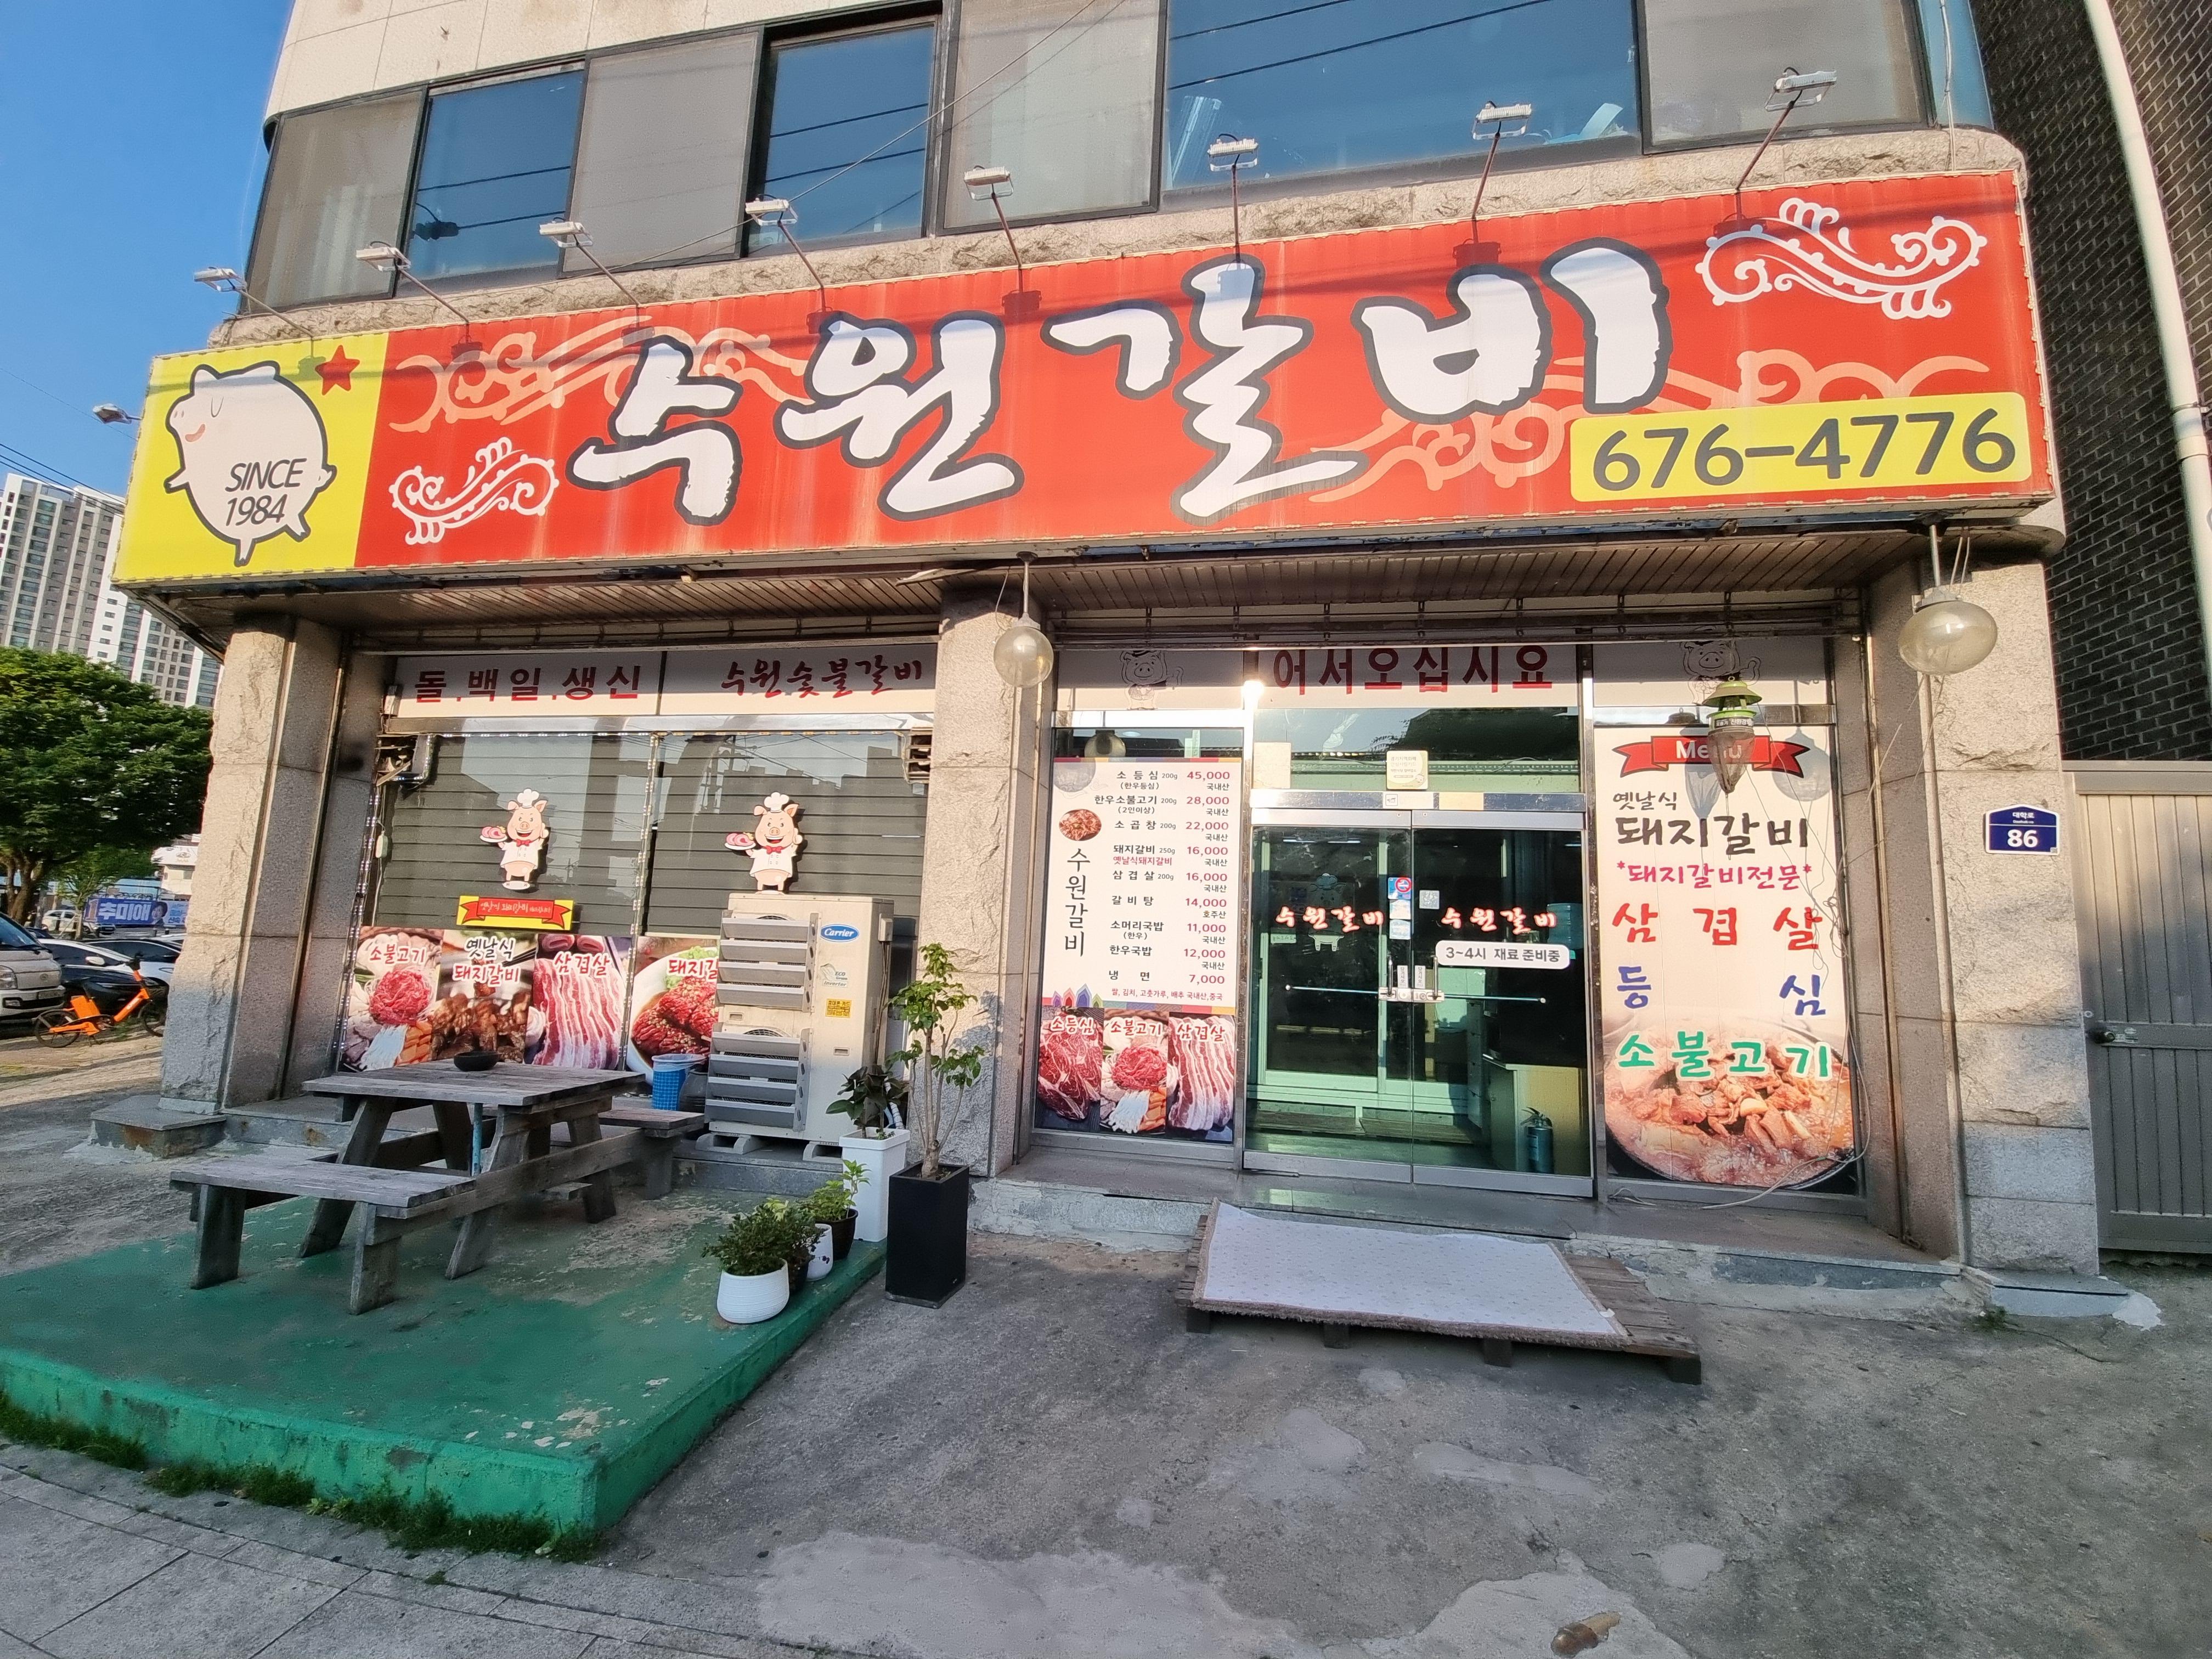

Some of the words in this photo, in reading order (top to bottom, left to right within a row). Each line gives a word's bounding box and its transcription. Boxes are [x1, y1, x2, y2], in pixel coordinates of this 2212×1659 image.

[566, 237, 1673, 526] 수원갈비
[1593, 408, 2016, 491] 676-4776
[225, 457, 308, 493] SINCE
[226, 494, 289, 526] 1984
[721, 654, 923, 699] 수원숯불갈비
[1273, 645, 1552, 695] 어서오십시요
[1187, 771, 1230, 781] 45,000
[1120, 782, 1159, 791] (한우등심)
[1207, 783, 1229, 791] 국내산
[1094, 795, 1157, 805] 한우소불고기
[1186, 796, 1229, 806] 28,000
[1613, 792, 1677, 811] 옛날식
[1118, 806, 1155, 815] (2인이상)
[1206, 808, 1228, 816] 국내산
[1186, 821, 1228, 832] 22,000
[1615, 812, 1808, 856] 돼지갈비
[1205, 833, 1228, 842] 국내산
[2007, 830, 2038, 847] 86
[1114, 844, 1155, 855] 돼지갈비
[1187, 847, 1228, 857] 16,000
[1113, 856, 1172, 866] 옛날식돼지갈비
[1204, 858, 1227, 867] 국내산
[1186, 872, 1227, 883] 16,000
[1204, 884, 1227, 893] 국내산
[86, 899, 99, 921] 1
[98, 902, 152, 921] 추미애
[1065, 848, 1091, 957] 수원갈비
[1185, 898, 1227, 909] 14,000
[1203, 910, 1226, 919] 호주산
[1276, 905, 1384, 932] 수원갈비
[1441, 906, 1558, 935] 수원갈비
[824, 928, 854, 937] Carrier
[1110, 921, 1164, 932] 소머리국밥
[1187, 923, 1226, 934] 11,000
[1123, 932, 1147, 940] (한우)
[1202, 936, 1226, 944] 국내산
[370, 943, 426, 964] 소불고기
[466, 938, 515, 958] 옛날식
[1109, 945, 1152, 956] 한우국밥
[1183, 949, 1226, 960] 12,000
[1446, 947, 1486, 960] 3~4시
[1494, 948, 1519, 961] 재료
[1522, 949, 1560, 962] 준비중
[554, 952, 611, 975] 삼겹살
[1201, 961, 1224, 970] 국내산
[453, 964, 521, 986] 돼지갈비
[1189, 975, 1225, 985] 7,000
[1051, 1017, 1093, 1034] 소등심
[1111, 1019, 1162, 1036] 소불고기
[1177, 1024, 1225, 1041] 삼겹살
[1618, 1031, 1827, 1077] 소불고기
